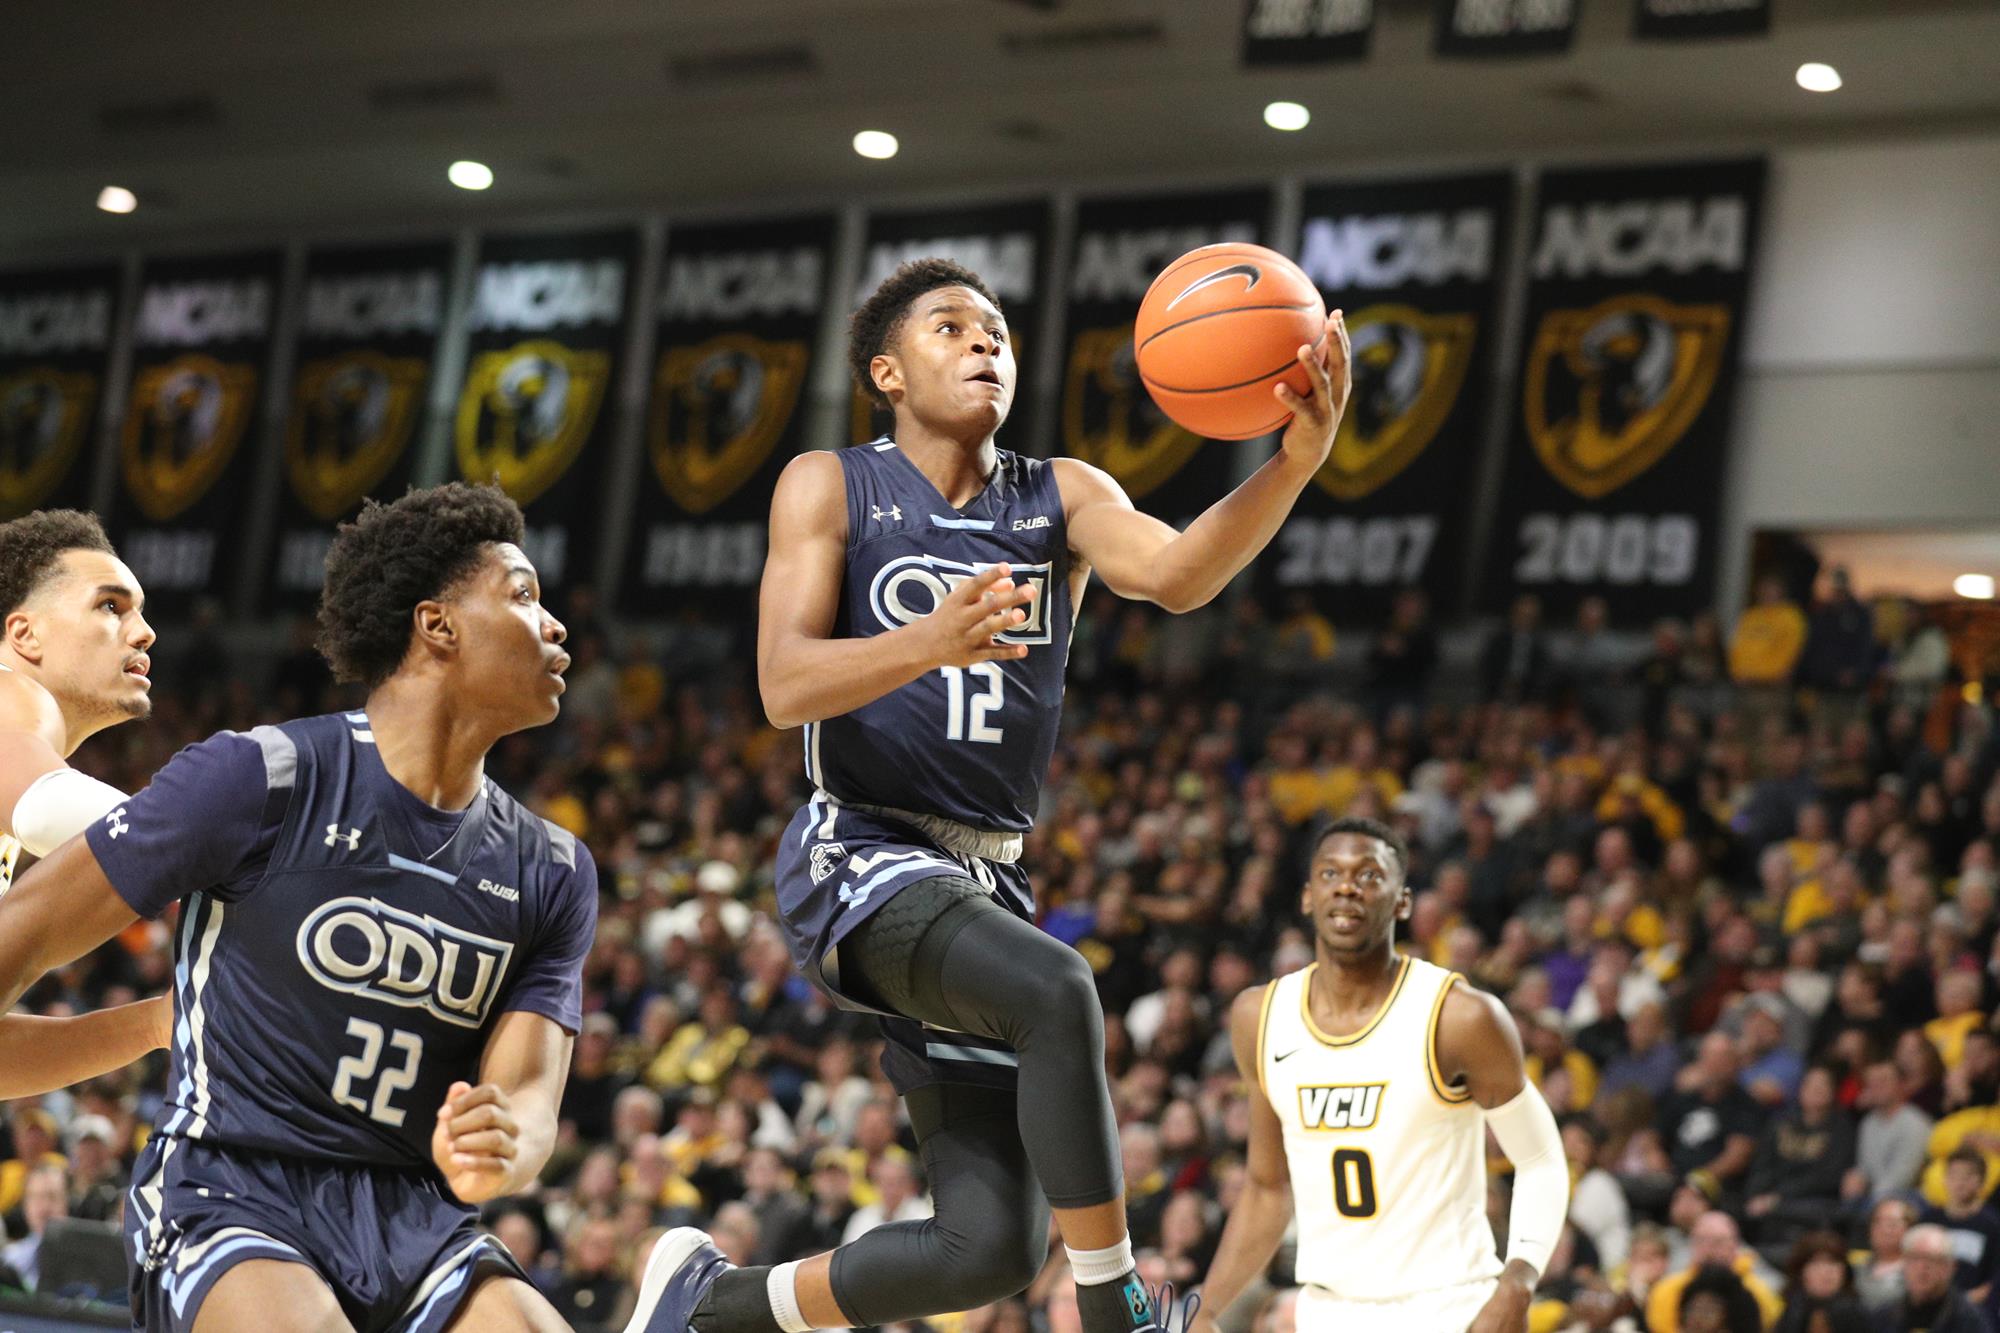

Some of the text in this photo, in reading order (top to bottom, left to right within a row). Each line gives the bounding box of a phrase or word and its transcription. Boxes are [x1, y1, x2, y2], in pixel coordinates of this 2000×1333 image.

[1301, 206, 1496, 292] NCAA
[1533, 196, 1747, 281] NCAA
[1276, 513, 1441, 587] 2007
[1514, 511, 1700, 585] 2009
[882, 567, 1044, 633] OU
[940, 660, 1004, 744] 12
[312, 910, 497, 1016] ODU
[331, 1016, 423, 1127] 22
[1299, 1084, 1387, 1129] VCU
[1332, 1148, 1376, 1218] 0
